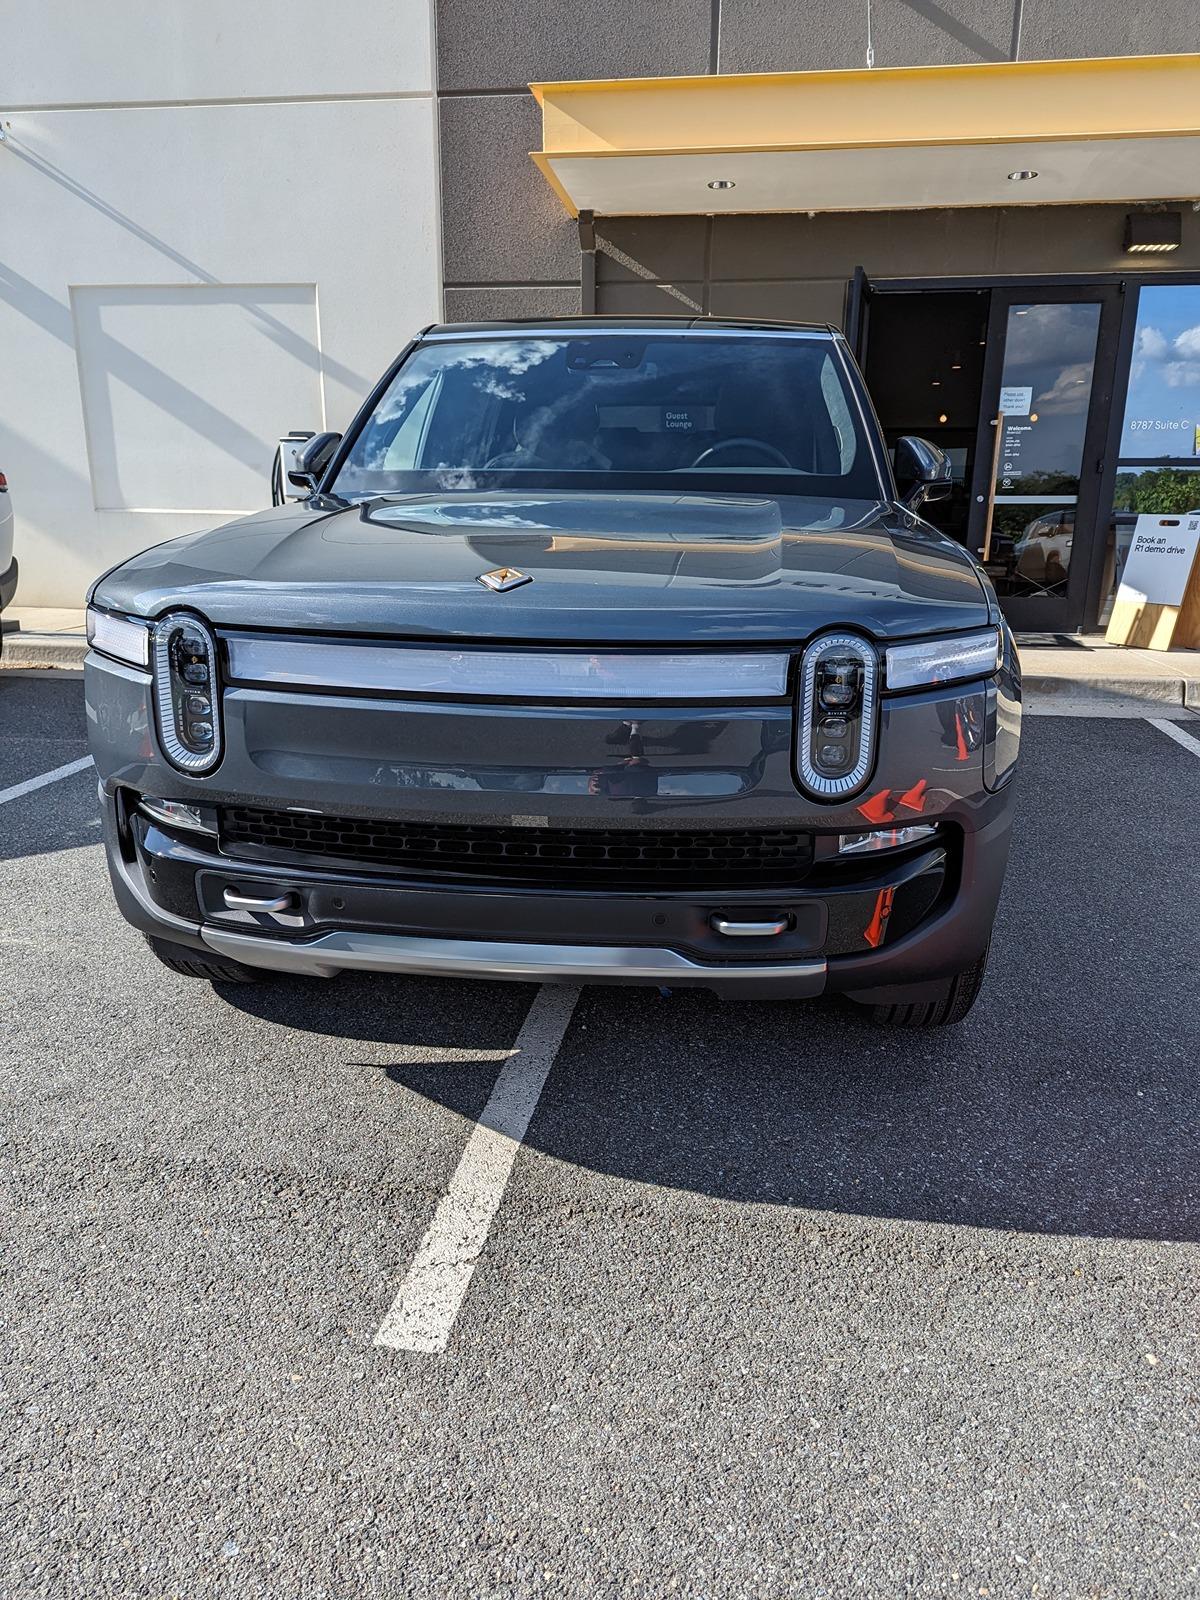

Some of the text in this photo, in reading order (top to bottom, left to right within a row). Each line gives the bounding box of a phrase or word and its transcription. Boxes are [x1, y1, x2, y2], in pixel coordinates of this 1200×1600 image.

[666, 420, 693, 429] Lounge
[1130, 420, 1190, 430] 8787 Suite C
[1136, 535, 1157, 544] Book
[1134, 544, 1186, 555] R1 demo drive
